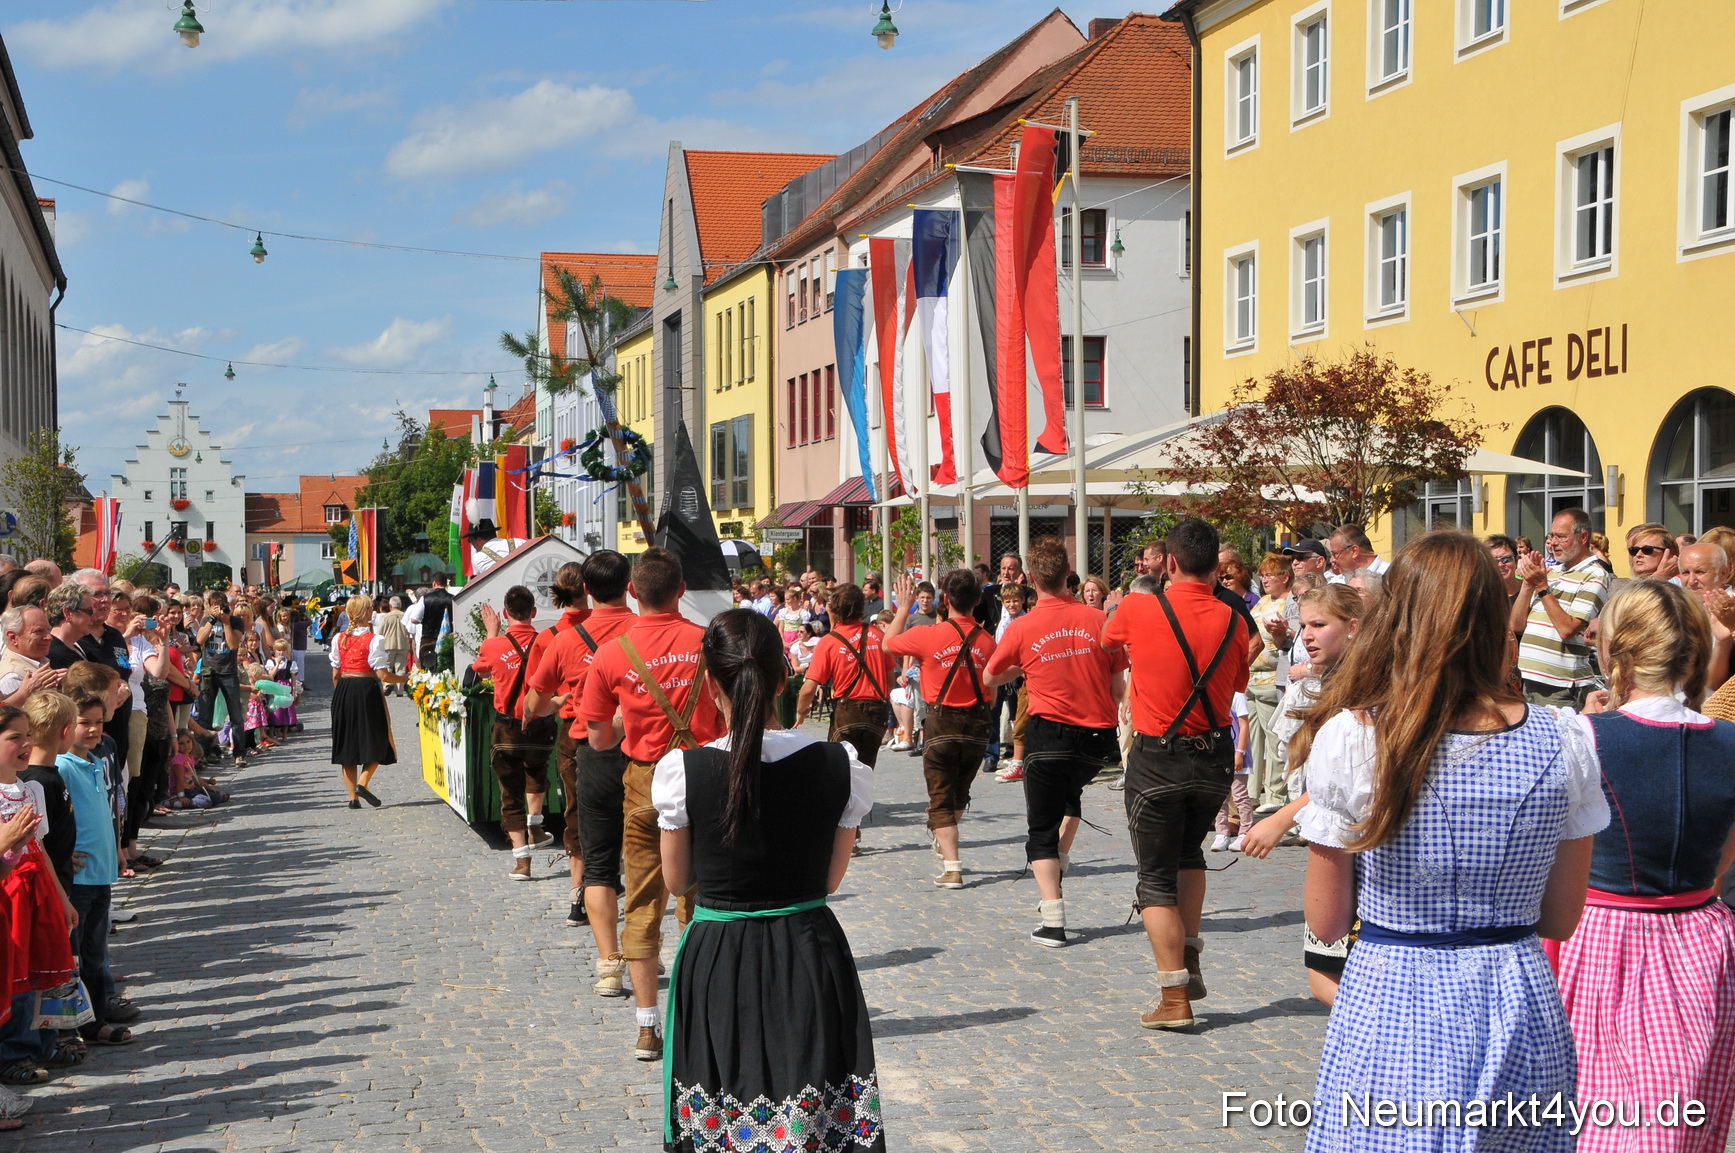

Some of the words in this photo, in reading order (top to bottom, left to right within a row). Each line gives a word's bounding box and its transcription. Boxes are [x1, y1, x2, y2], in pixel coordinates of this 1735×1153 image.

[1485, 336, 1553, 392] CAFE
[1567, 323, 1628, 381] DELI
[770, 530, 800, 538] Klostergasse
[1031, 627, 1096, 653] Hasenheider
[625, 651, 699, 683] Hsenheid
